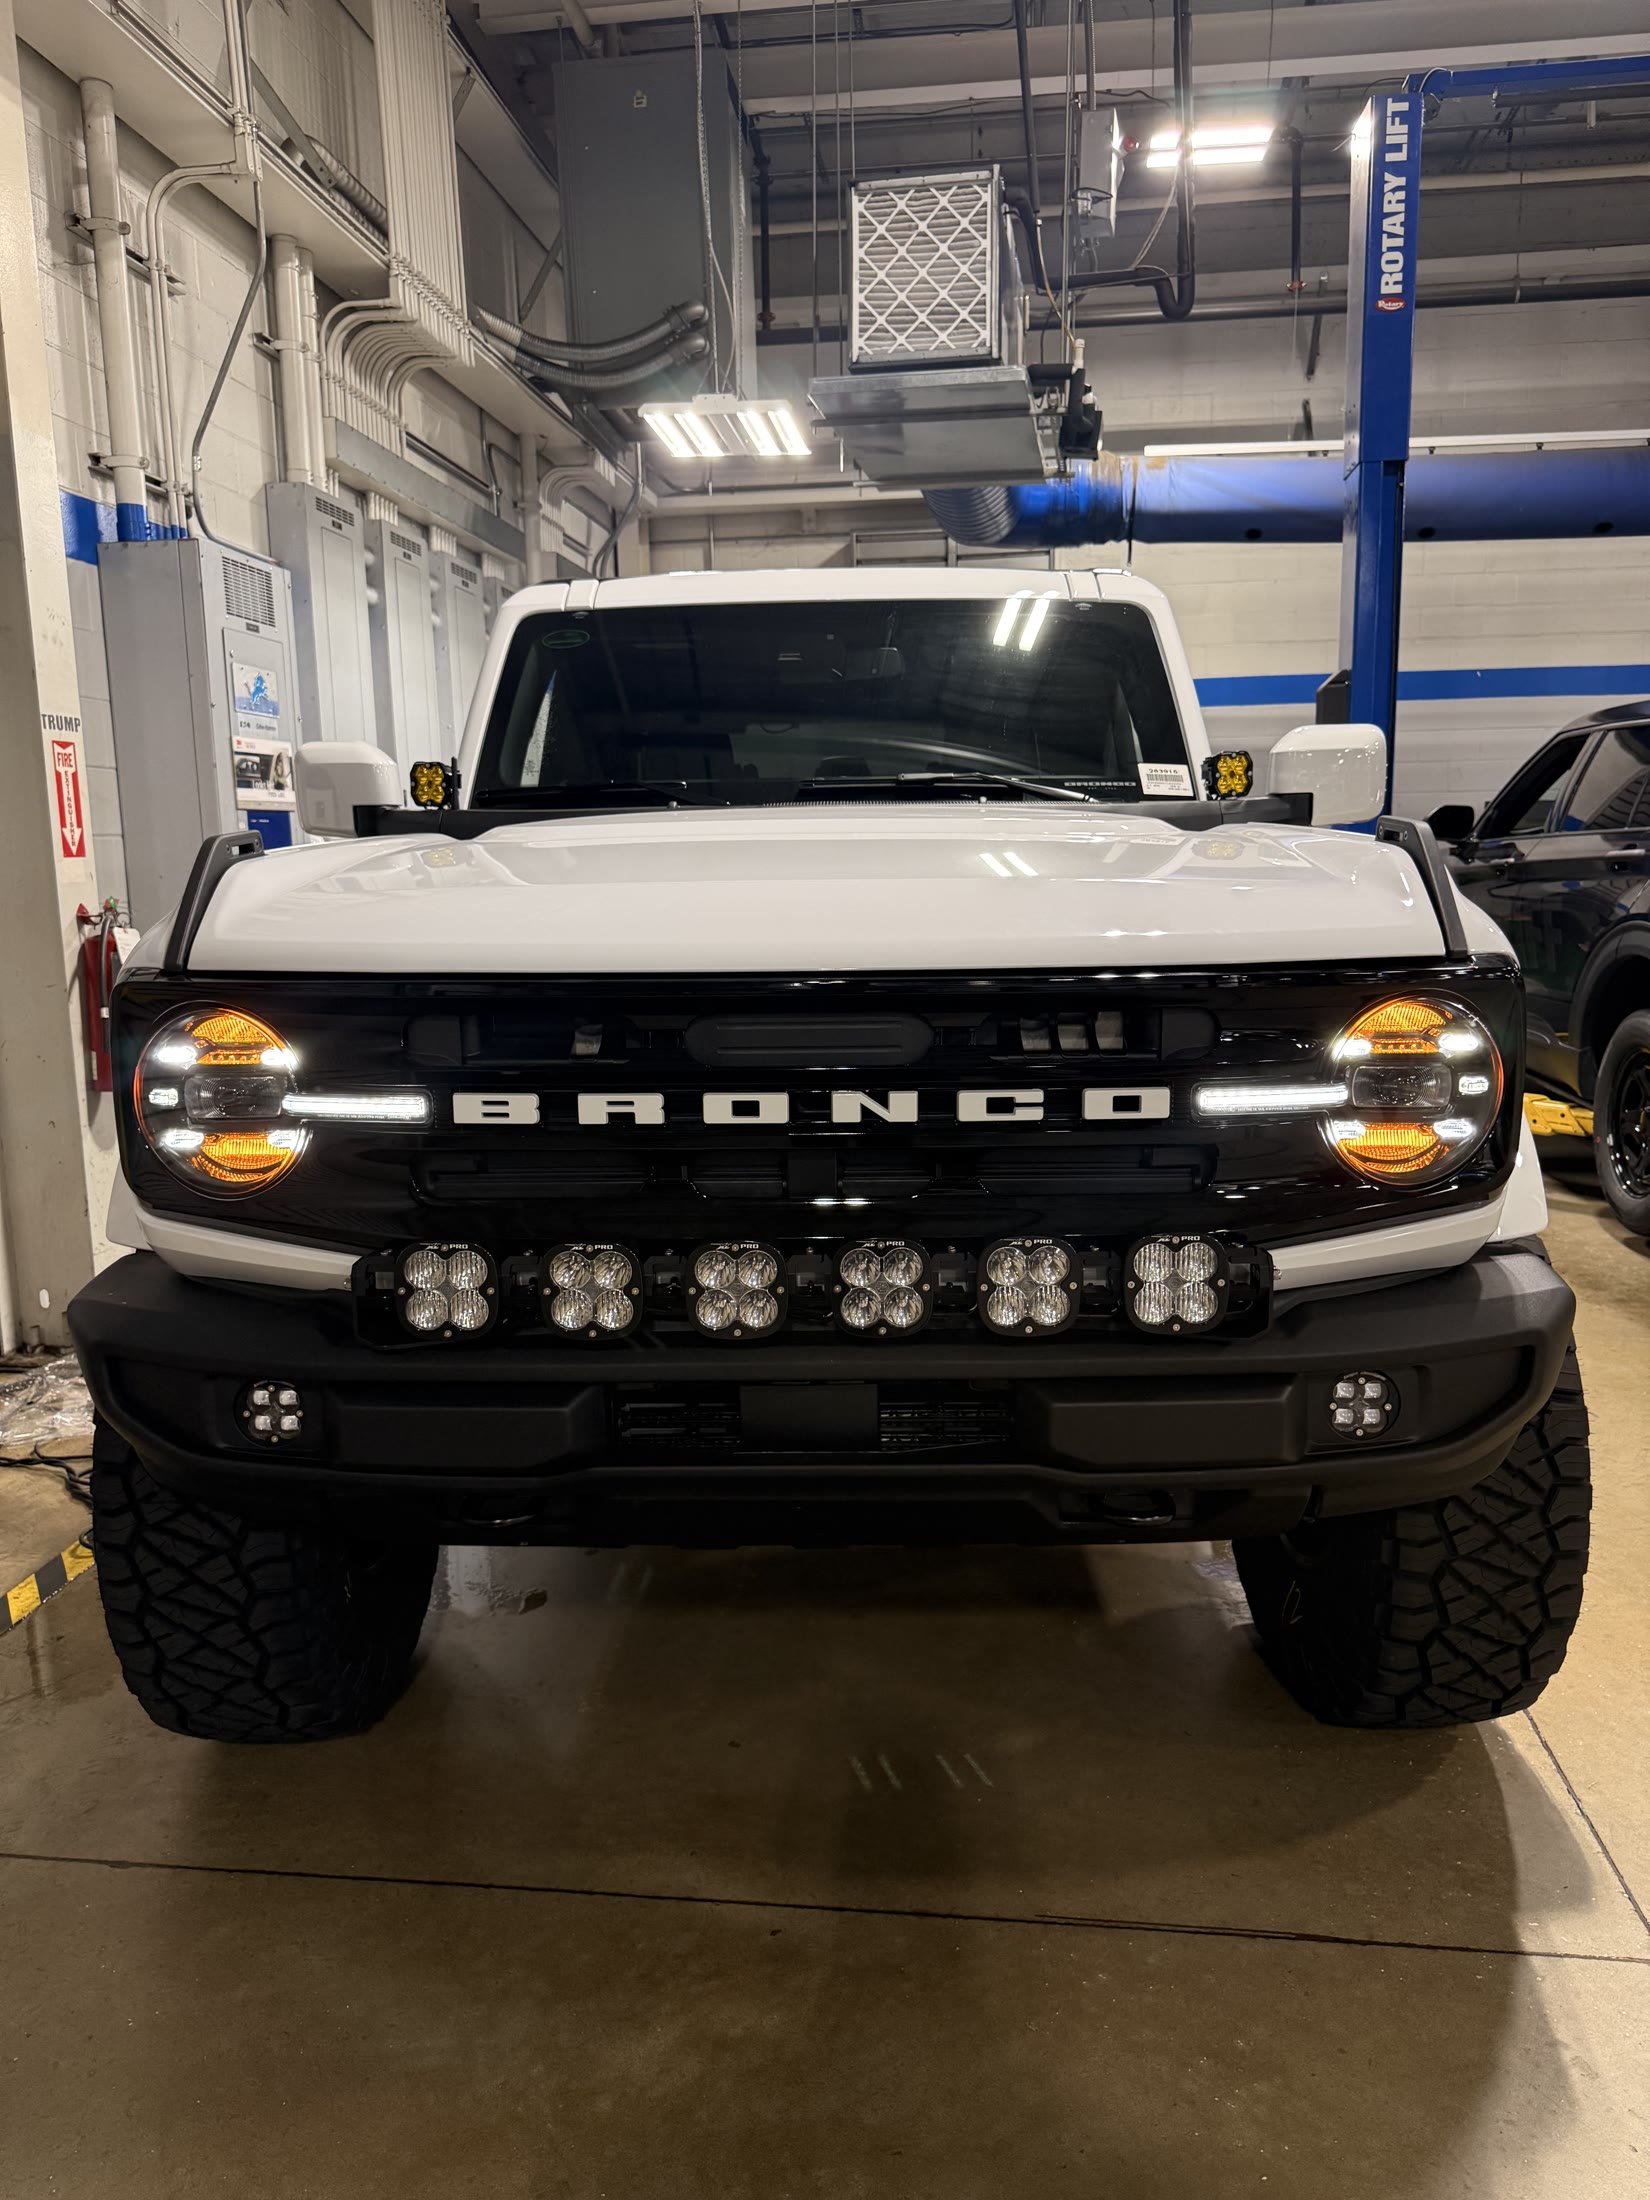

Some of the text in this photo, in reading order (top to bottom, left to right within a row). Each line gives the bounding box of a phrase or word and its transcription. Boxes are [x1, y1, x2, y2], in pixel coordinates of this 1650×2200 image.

[1380, 98, 1409, 294] ROTARY LIFT
[41, 714, 81, 733] TRUMP
[56, 752, 73, 768] FIRE
[64, 770, 76, 847] EXTINGUISHER
[453, 1087, 1171, 1124] BRONCO
